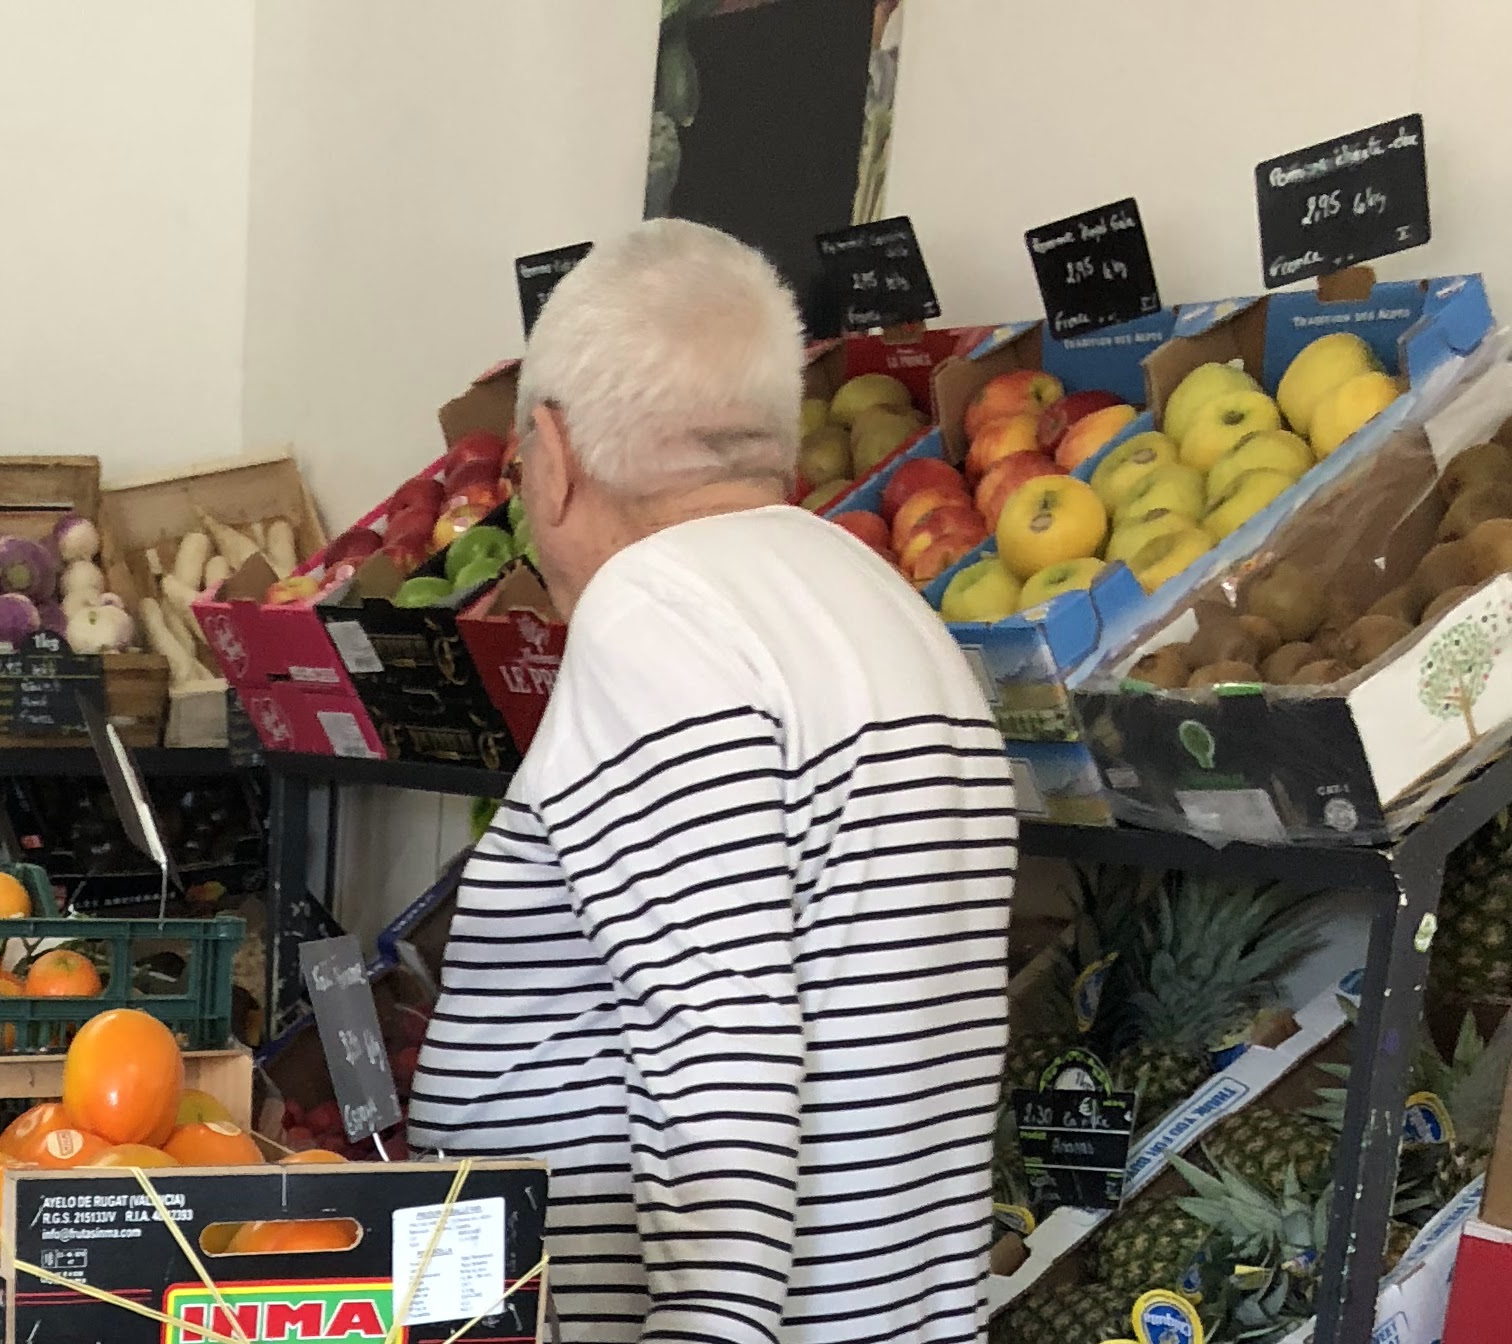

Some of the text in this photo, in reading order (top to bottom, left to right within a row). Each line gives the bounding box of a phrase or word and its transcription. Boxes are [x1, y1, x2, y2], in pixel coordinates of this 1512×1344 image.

[42, 1195, 76, 1209] AYELO
[78, 1195, 92, 1208] DE
[93, 1194, 129, 1207] RUGAT
[179, 1299, 388, 1344] INMA
